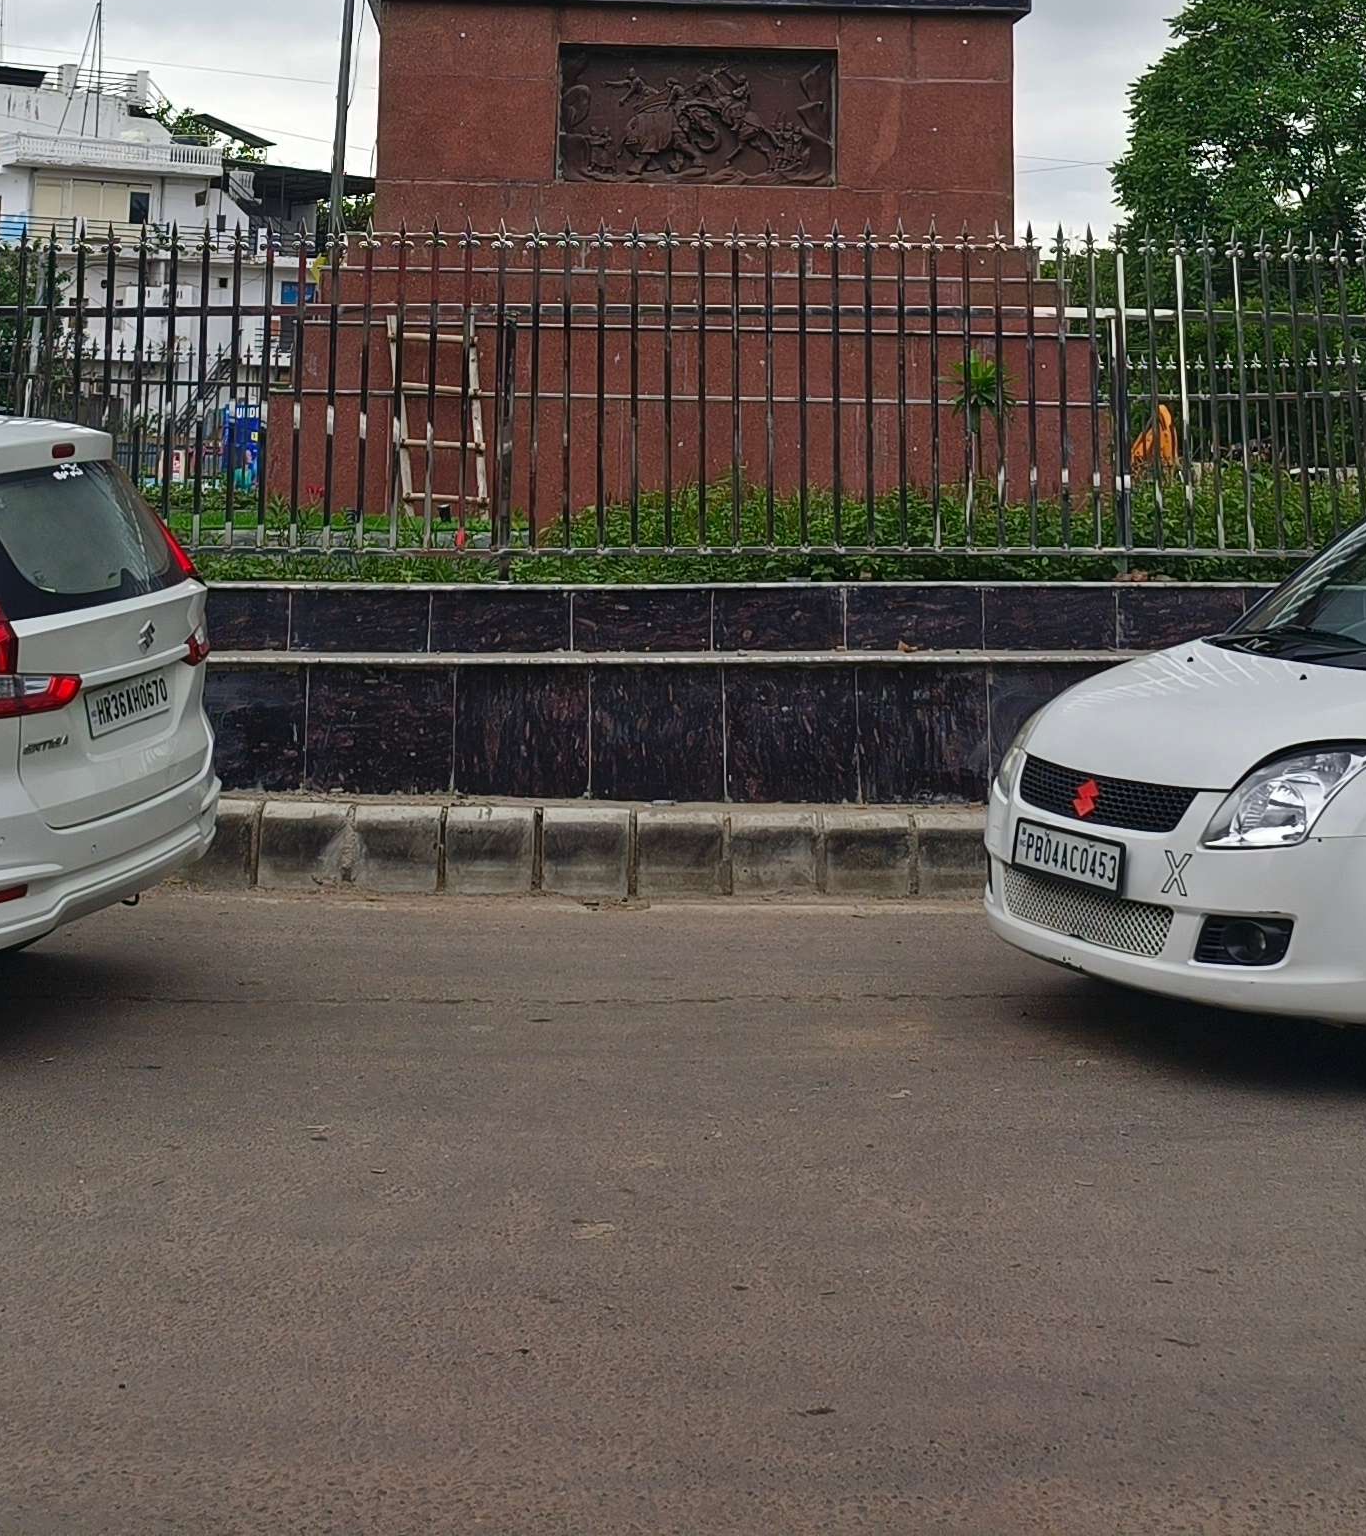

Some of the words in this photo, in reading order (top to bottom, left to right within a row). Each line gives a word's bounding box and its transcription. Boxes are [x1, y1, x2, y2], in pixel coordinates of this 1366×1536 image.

[95, 677, 168, 725] HR36AH0670
[1025, 832, 1117, 883] PB04AC0453
[1161, 850, 1193, 897] X
